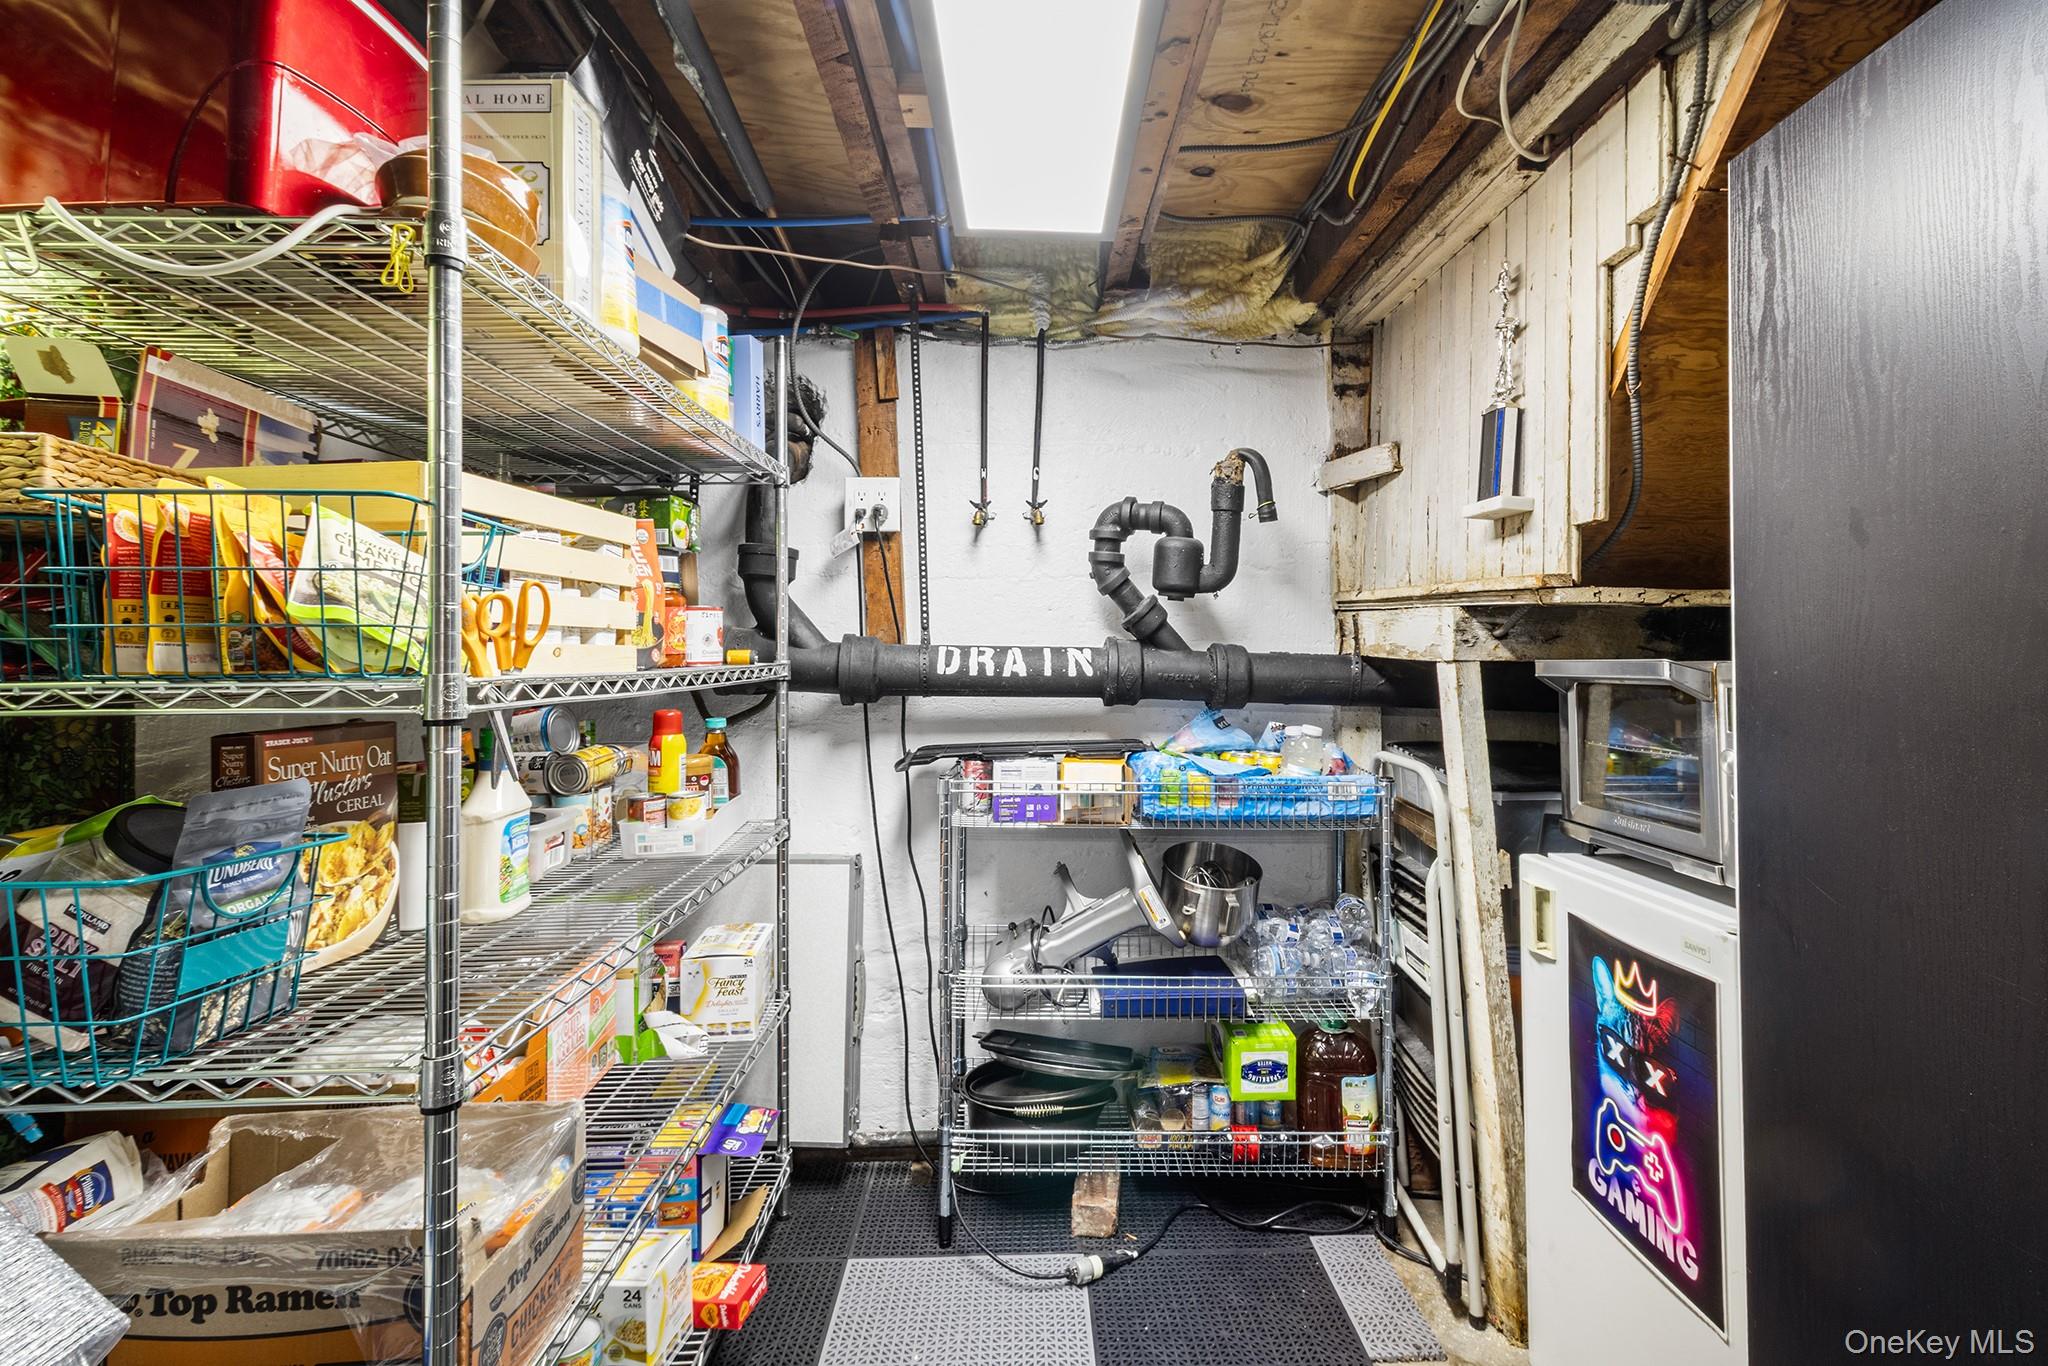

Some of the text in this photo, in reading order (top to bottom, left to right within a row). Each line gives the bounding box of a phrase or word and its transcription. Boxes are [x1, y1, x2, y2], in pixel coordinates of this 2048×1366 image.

[462, 93, 546, 105] AL HOME
[936, 645, 1094, 677] DRAIN
[222, 752, 244, 761] Super
[221, 760, 245, 770] Nutty
[267, 744, 392, 783] Super Nutty Oat
[226, 767, 240, 777] Oat
[336, 793, 386, 815] CEREAL
[222, 878, 242, 889] FAMILY
[26, 961, 43, 975] FINE
[707, 977, 746, 988] Fancy
[715, 986, 745, 998] Feast
[1248, 1073, 1281, 1084] SPARKLING
[1588, 1157, 1699, 1281] GAMING
[507, 1209, 571, 1295] Top Ramen
[623, 1289, 642, 1302] 24
[146, 1284, 362, 1325] Top Ramen
[510, 1265, 562, 1349] CHICKEN
